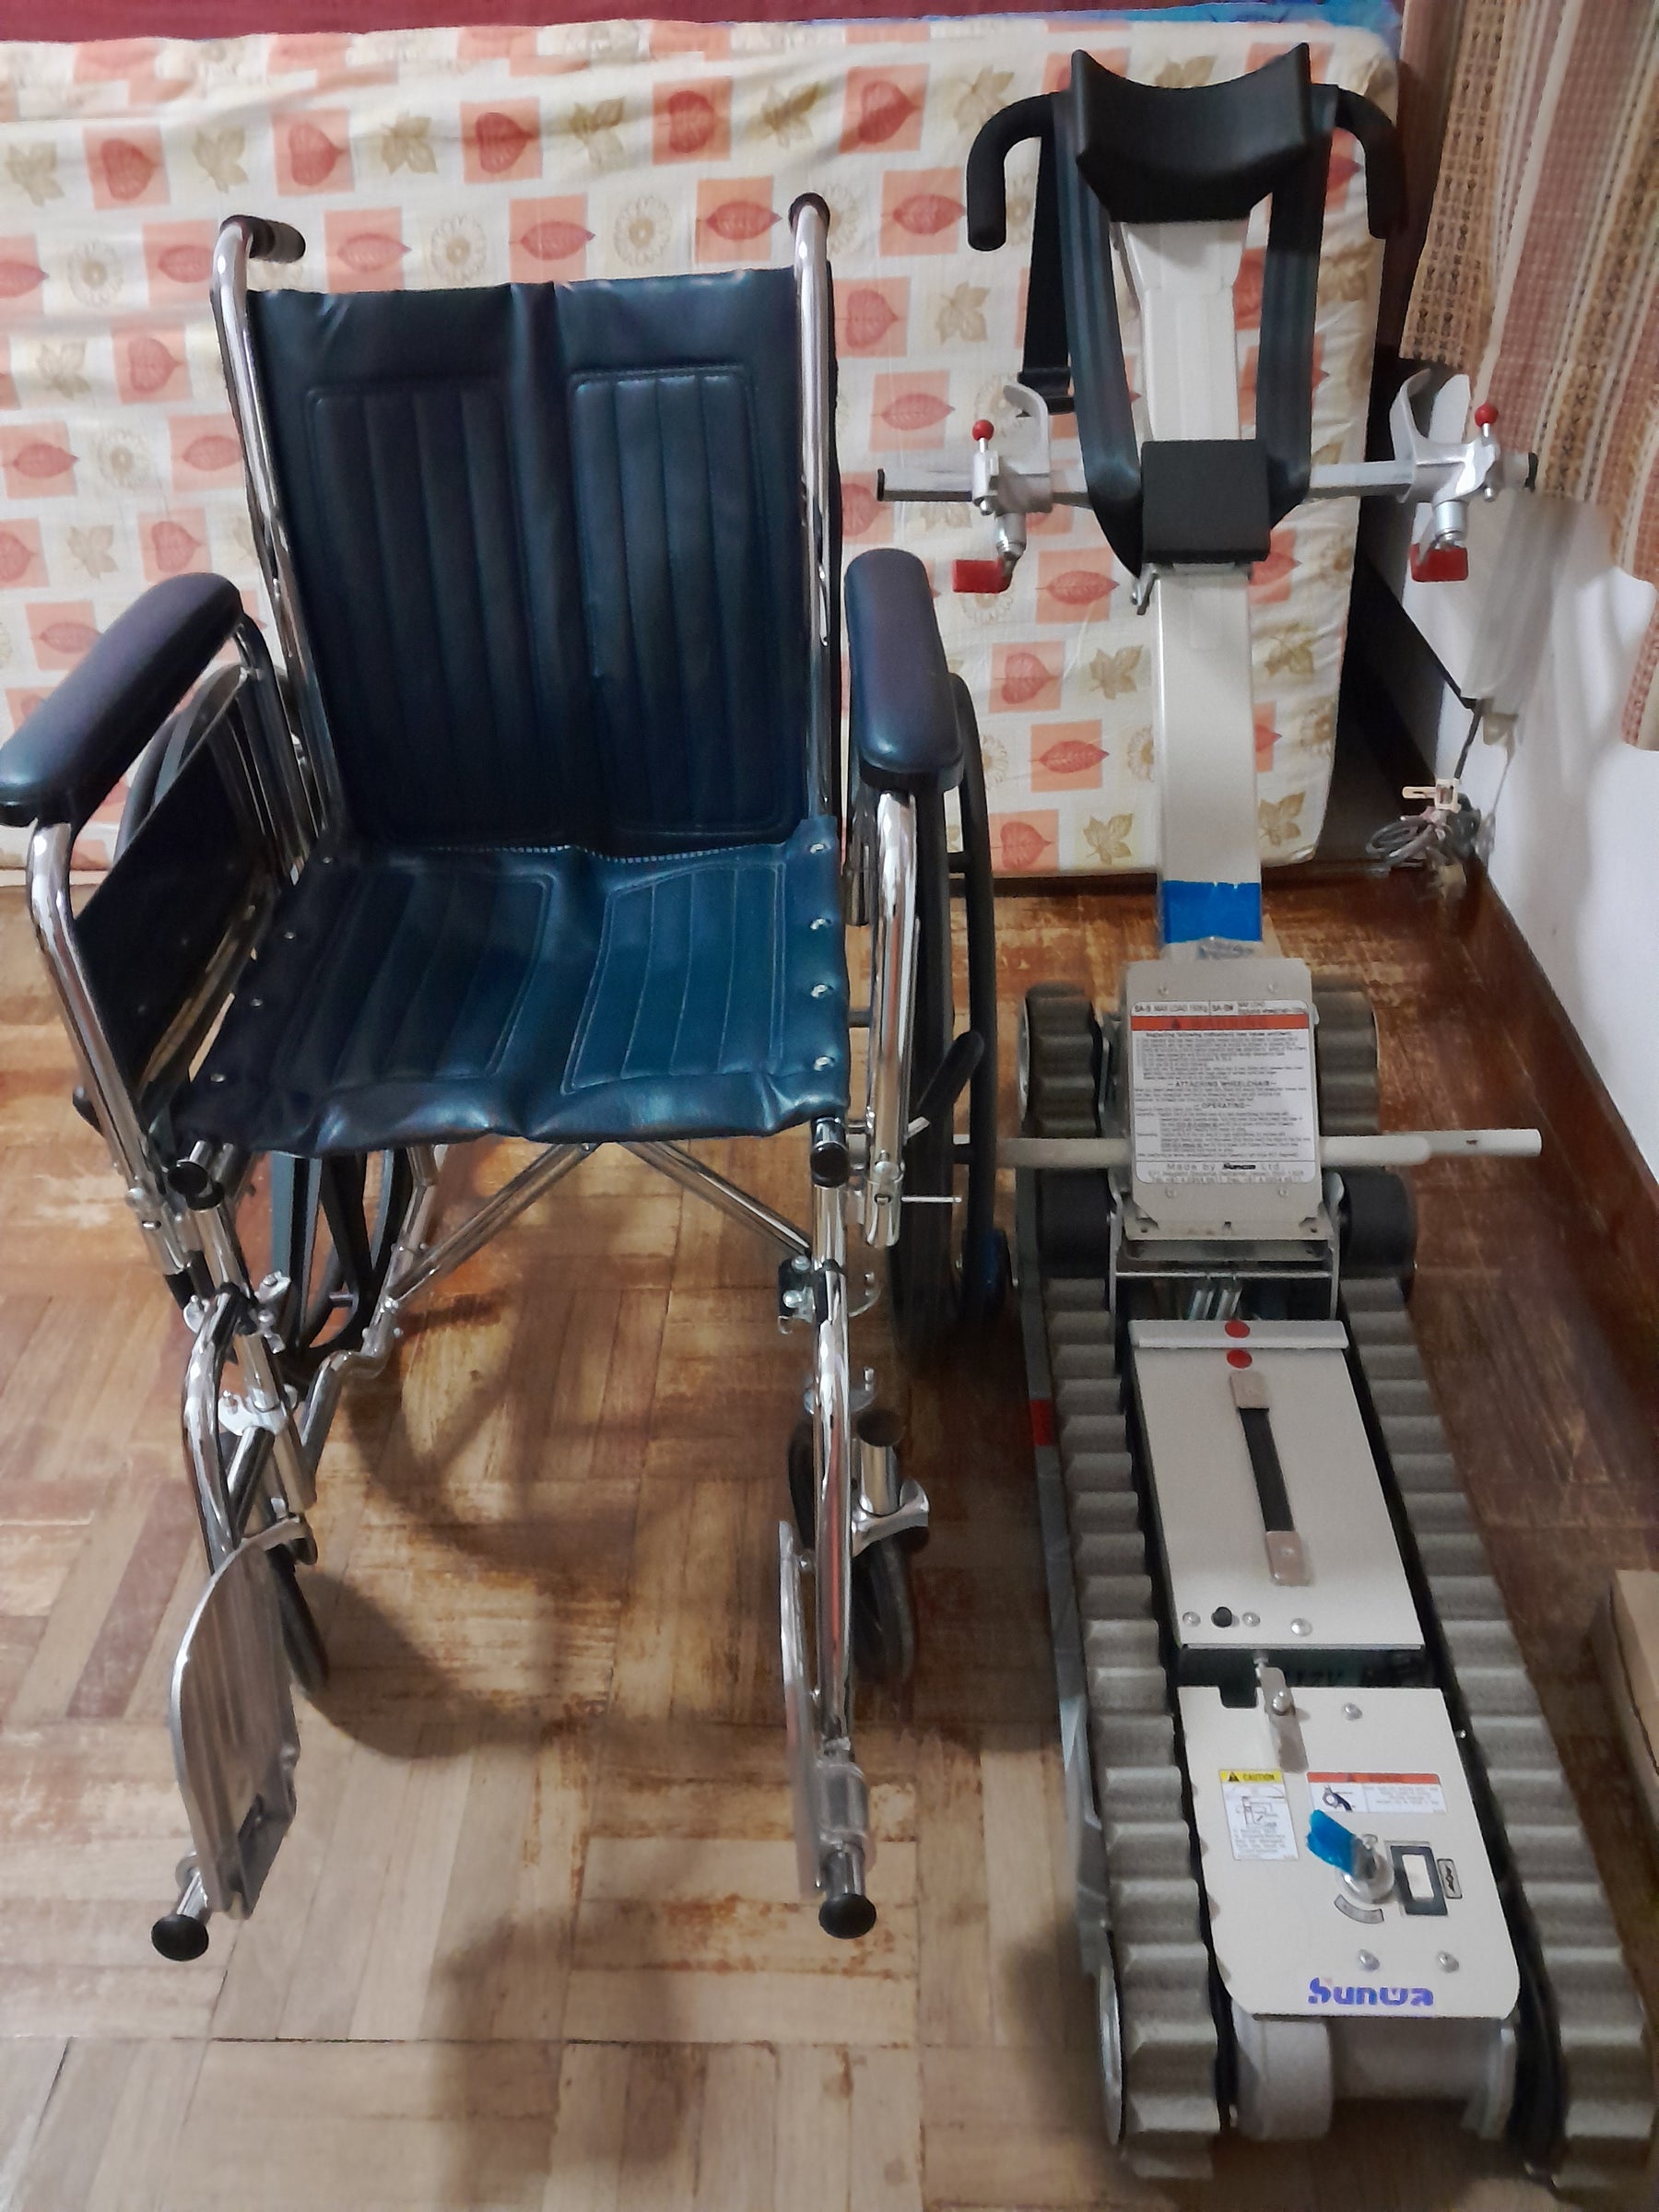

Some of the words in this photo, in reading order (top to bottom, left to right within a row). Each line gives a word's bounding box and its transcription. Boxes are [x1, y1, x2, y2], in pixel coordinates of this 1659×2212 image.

[1167, 1162, 1197, 1171] Made
[1203, 1162, 1216, 1171] by
[1308, 1977, 1434, 2006] Sunwa
